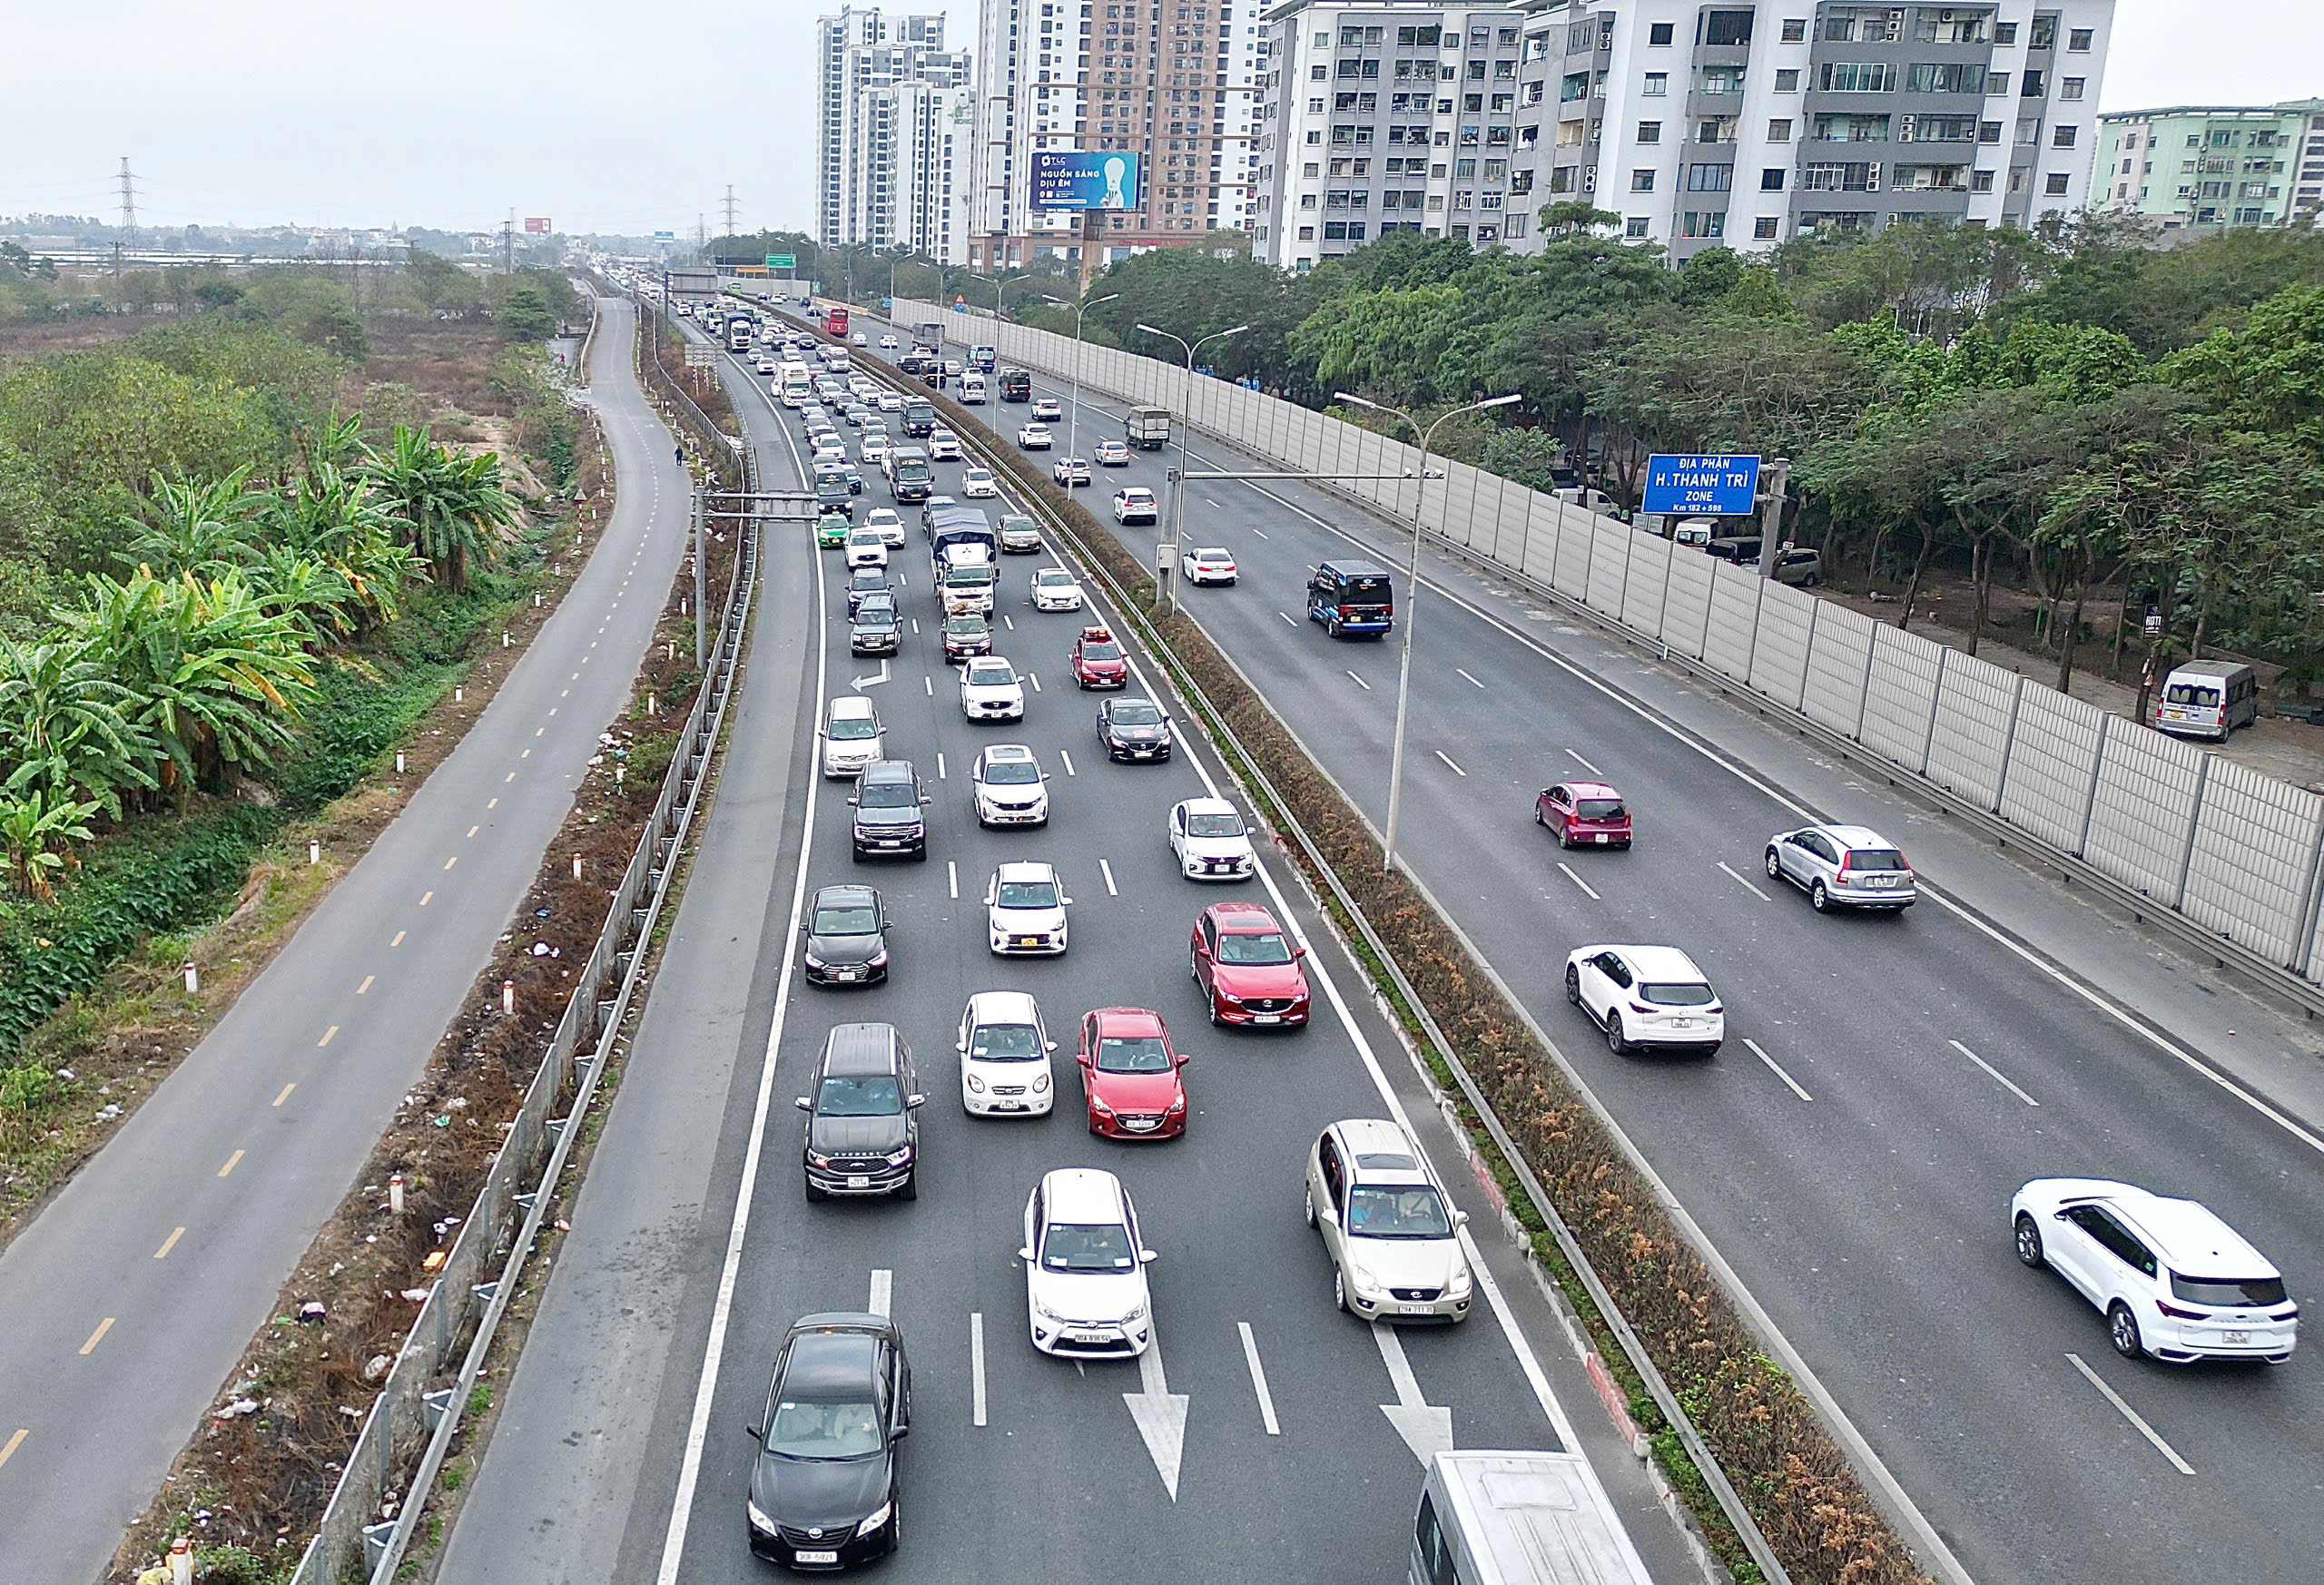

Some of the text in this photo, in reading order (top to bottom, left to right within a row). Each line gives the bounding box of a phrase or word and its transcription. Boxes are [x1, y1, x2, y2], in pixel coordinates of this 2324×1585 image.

[1075, 168, 1100, 178] SÁNG
[1039, 178, 1071, 189] DỊU ÊM
[1679, 456, 1730, 472] ĐỊA PHẬN
[1655, 470, 1748, 487] H.THANH TRÌ
[1685, 491, 1713, 502] ZONE
[1672, 504, 1687, 512] Km
